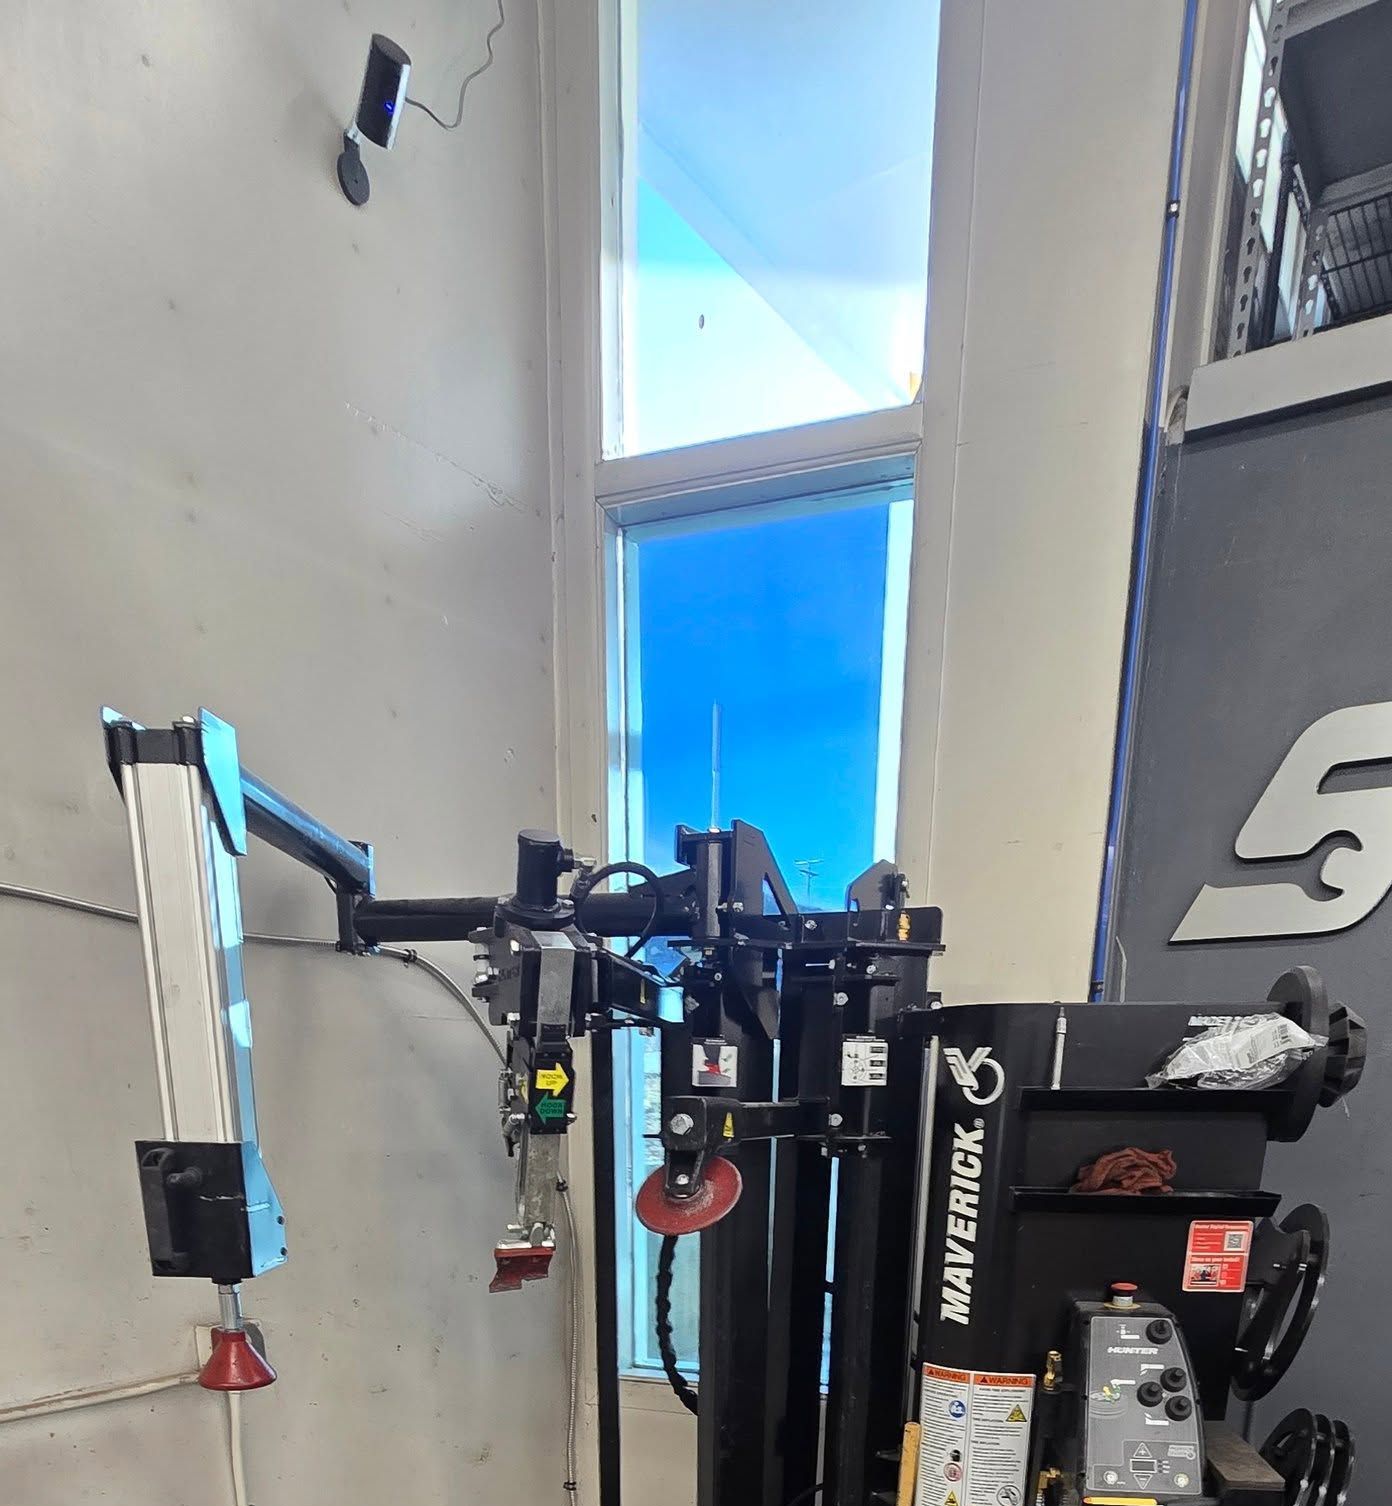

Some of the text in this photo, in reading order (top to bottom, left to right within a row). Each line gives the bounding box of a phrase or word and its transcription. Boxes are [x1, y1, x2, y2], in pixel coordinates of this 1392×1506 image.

[1107, 1346, 1159, 1355] HUNTER
[935, 1370, 967, 1381] WARNING
[989, 1376, 1029, 1385] WARNING
